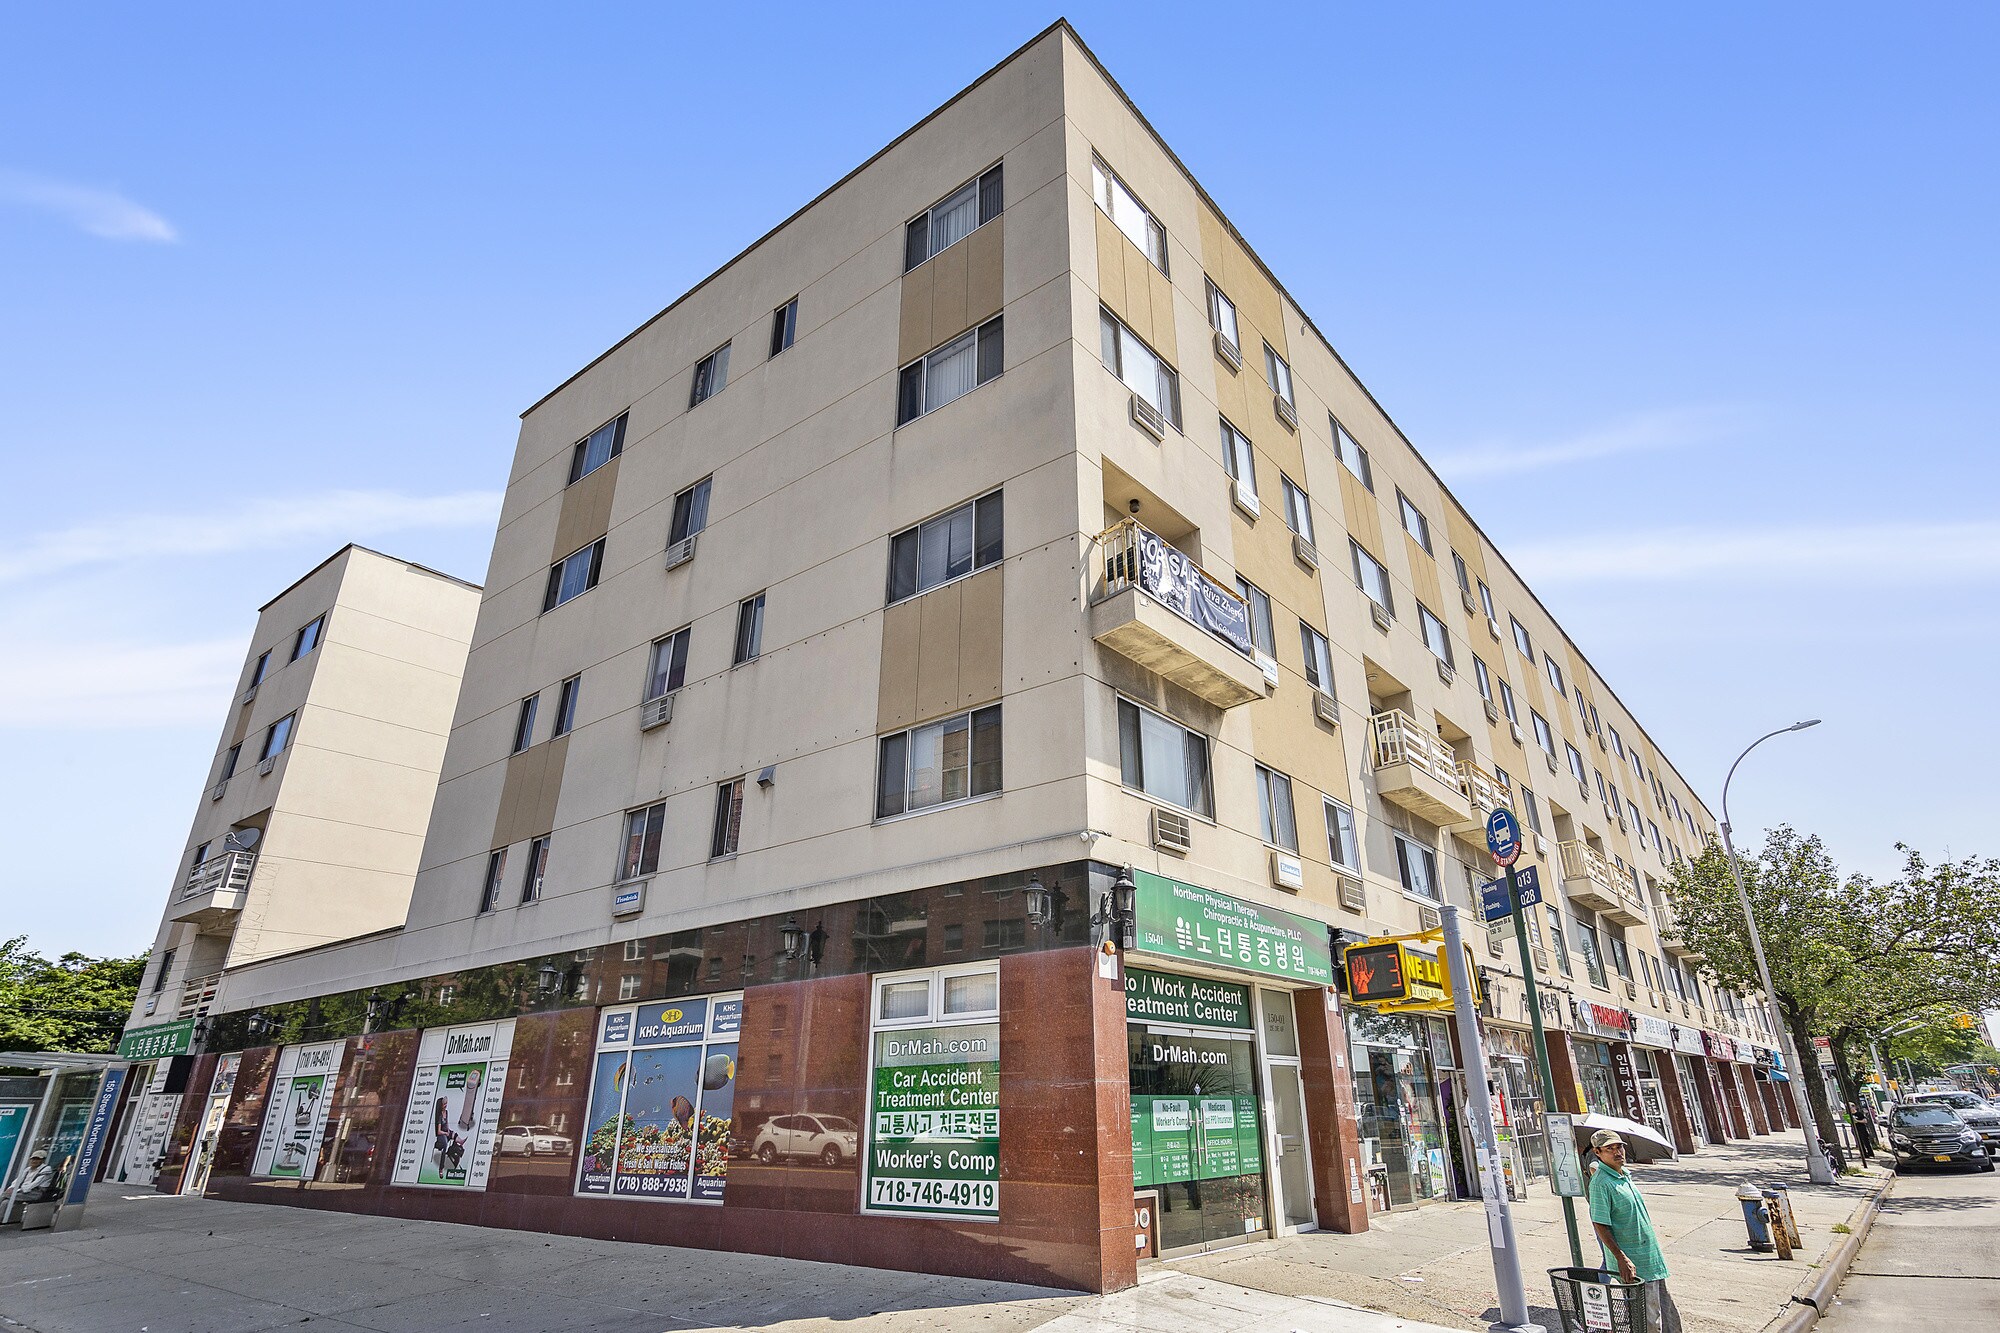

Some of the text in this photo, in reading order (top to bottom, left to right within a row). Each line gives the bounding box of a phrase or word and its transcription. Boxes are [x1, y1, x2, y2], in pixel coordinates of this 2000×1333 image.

[1139, 530, 1165, 567] FOR
[1168, 554, 1200, 592] SALE
[1203, 584, 1221, 604] Riva
[1220, 596, 1244, 623] Zheng
[1492, 841, 1520, 867] NO STANDING
[1517, 871, 1531, 887] Q13
[1483, 884, 1498, 894] Flushing
[1520, 889, 1536, 906] Q28
[1173, 884, 1259, 919] Northern Physical Therapy,
[1485, 901, 1500, 911] Flushing
[1203, 907, 1302, 942] Chiropractic & Acupuncture, PLLC
[1489, 919, 1503, 928] Northern
[1144, 932, 1164, 946] 150-01
[1195, 922, 1305, 973] 노던통증병원
[1405, 953, 1424, 981] NE
[1124, 973, 1137, 992] to
[1151, 976, 1187, 999] Work
[1190, 982, 1243, 1006] Accident
[714, 1010, 742, 1022] Aquarium
[722, 1004, 737, 1012] KHC
[1125, 997, 1238, 1023] eatment Center
[613, 1016, 625, 1024] KHC
[1267, 1012, 1286, 1025] 150-01
[606, 1024, 629, 1032] Aquarium
[639, 1022, 704, 1039] KHC Aquarium
[448, 1033, 491, 1055] DrMah.com
[888, 1038, 988, 1057] DrMah.com
[1153, 1044, 1228, 1065] DrMah.com
[105, 1080, 117, 1092] 150
[893, 1067, 982, 1088] Car Accident
[1616, 1053, 1640, 1120] 인터넷 PC
[98, 1093, 112, 1115] Street
[879, 1088, 998, 1108] Treatment Center
[1162, 1102, 1182, 1112] No-Fault
[1208, 1102, 1226, 1112] Medicare
[879, 1112, 998, 1135] 교통사고 치료전문
[1156, 1116, 1175, 1126] Worker's
[85, 1124, 102, 1157] Northern
[635, 1143, 645, 1154] We
[78, 1158, 91, 1176] Blvd
[623, 1158, 687, 1171] Fresh & Salt Water Fishes
[876, 1149, 996, 1176] Worker's Comp
[584, 1173, 611, 1183] Aquarium
[617, 1176, 687, 1193] (718) 888-7938
[875, 1180, 995, 1208] 718-746-4919
